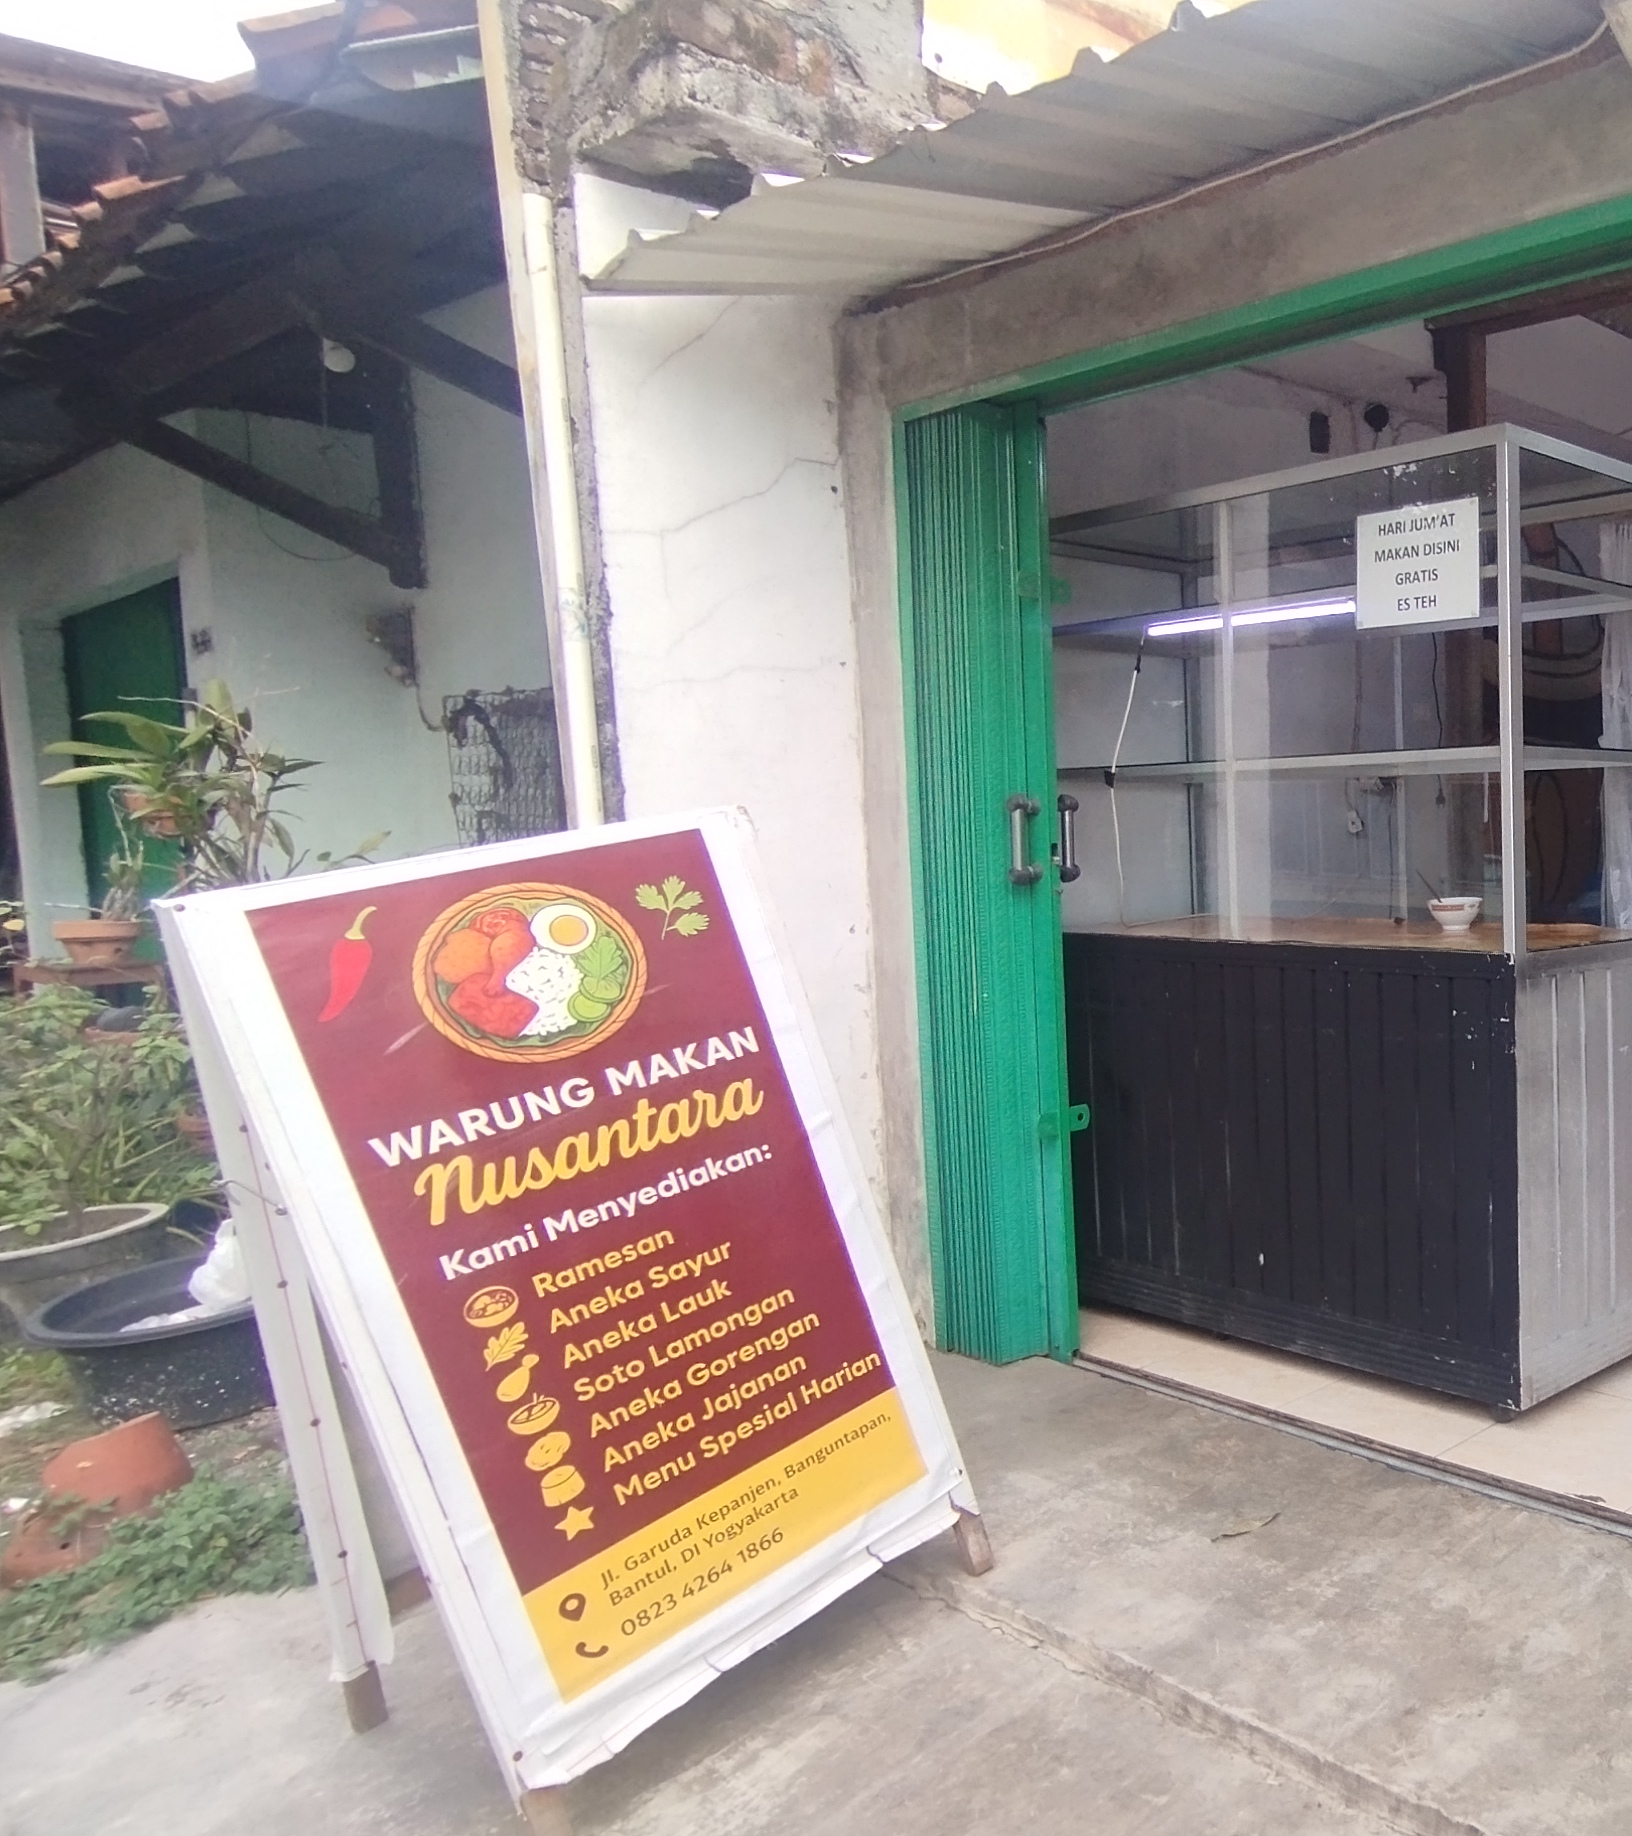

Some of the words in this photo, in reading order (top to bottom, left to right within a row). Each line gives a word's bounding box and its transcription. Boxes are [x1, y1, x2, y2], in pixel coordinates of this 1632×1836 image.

[1374, 545, 1420, 563] MAKAN
[1423, 539, 1460, 556] DISINI
[1378, 520, 1406, 536] HARI
[1395, 568, 1439, 586] GRATIS
[1397, 598, 1411, 611] ES
[1413, 595, 1437, 609] TEH
[367, 1077, 595, 1167] WARUNG
[604, 1026, 760, 1096] MAKAN
[413, 1077, 765, 1225] Nusantara
[439, 1223, 540, 1280] Kami
[541, 1143, 772, 1242] Menyediakan:
[531, 1230, 675, 1297] Ramesan
[550, 1279, 645, 1333] Aneka
[648, 1241, 732, 1289] Sayur
[563, 1312, 658, 1369] Aneka
[660, 1277, 733, 1323] Lauk
[573, 1358, 646, 1401] Soto
[648, 1288, 796, 1368] Lamongan
[590, 1378, 683, 1438] Aneka
[686, 1312, 821, 1387] Gorengan
[603, 1412, 696, 1473] Aneka
[701, 1356, 807, 1421] Jajanan
[612, 1452, 697, 1506] Menu
[699, 1391, 798, 1459] Spesial
[800, 1352, 882, 1405] Harian
[600, 1568, 620, 1590] Jl.
[623, 1526, 693, 1571] Garuda
[695, 1476, 783, 1530] Kepanjen,
[783, 1411, 892, 1479] Banguntapan,
[608, 1559, 678, 1607] Bantul,
[680, 1542, 702, 1565] DI
[702, 1487, 800, 1548] Yogyakarta
[620, 1595, 679, 1637] 0823
[681, 1558, 734, 1599] 4264
[735, 1526, 785, 1564] 1866
